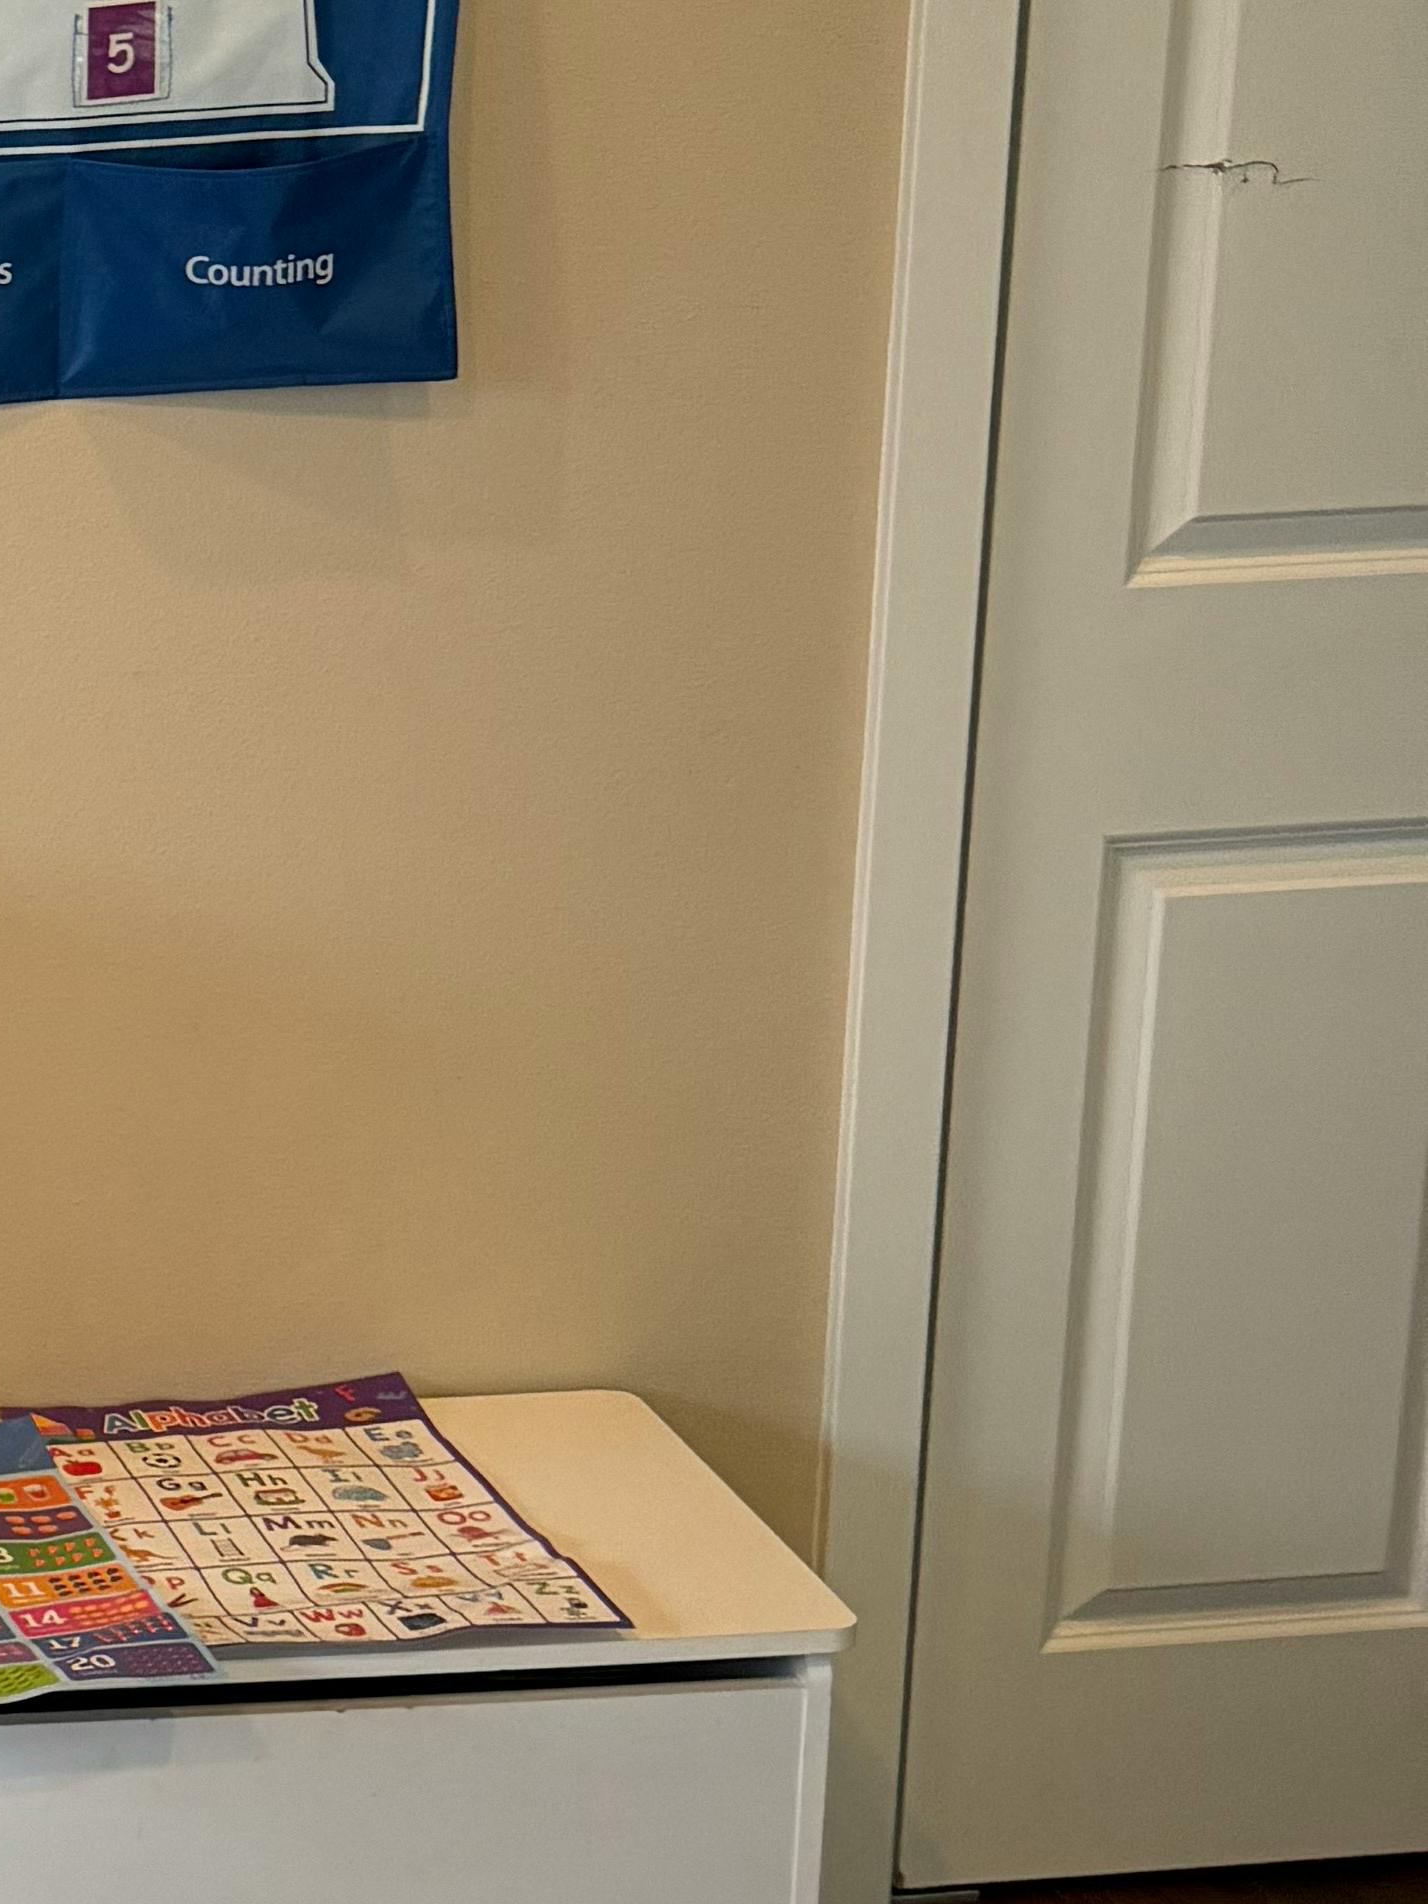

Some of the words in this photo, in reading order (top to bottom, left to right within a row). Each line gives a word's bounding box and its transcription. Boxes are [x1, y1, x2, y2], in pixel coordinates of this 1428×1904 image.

[107, 34, 134, 74] 5
[185, 250, 334, 288] Counting
[104, 1398, 318, 1434] Alphabet
[3, 1582, 46, 1597] 11
[20, 1609, 66, 1628] 14
[49, 1637, 81, 1650] 17
[65, 1655, 116, 1671] 20
